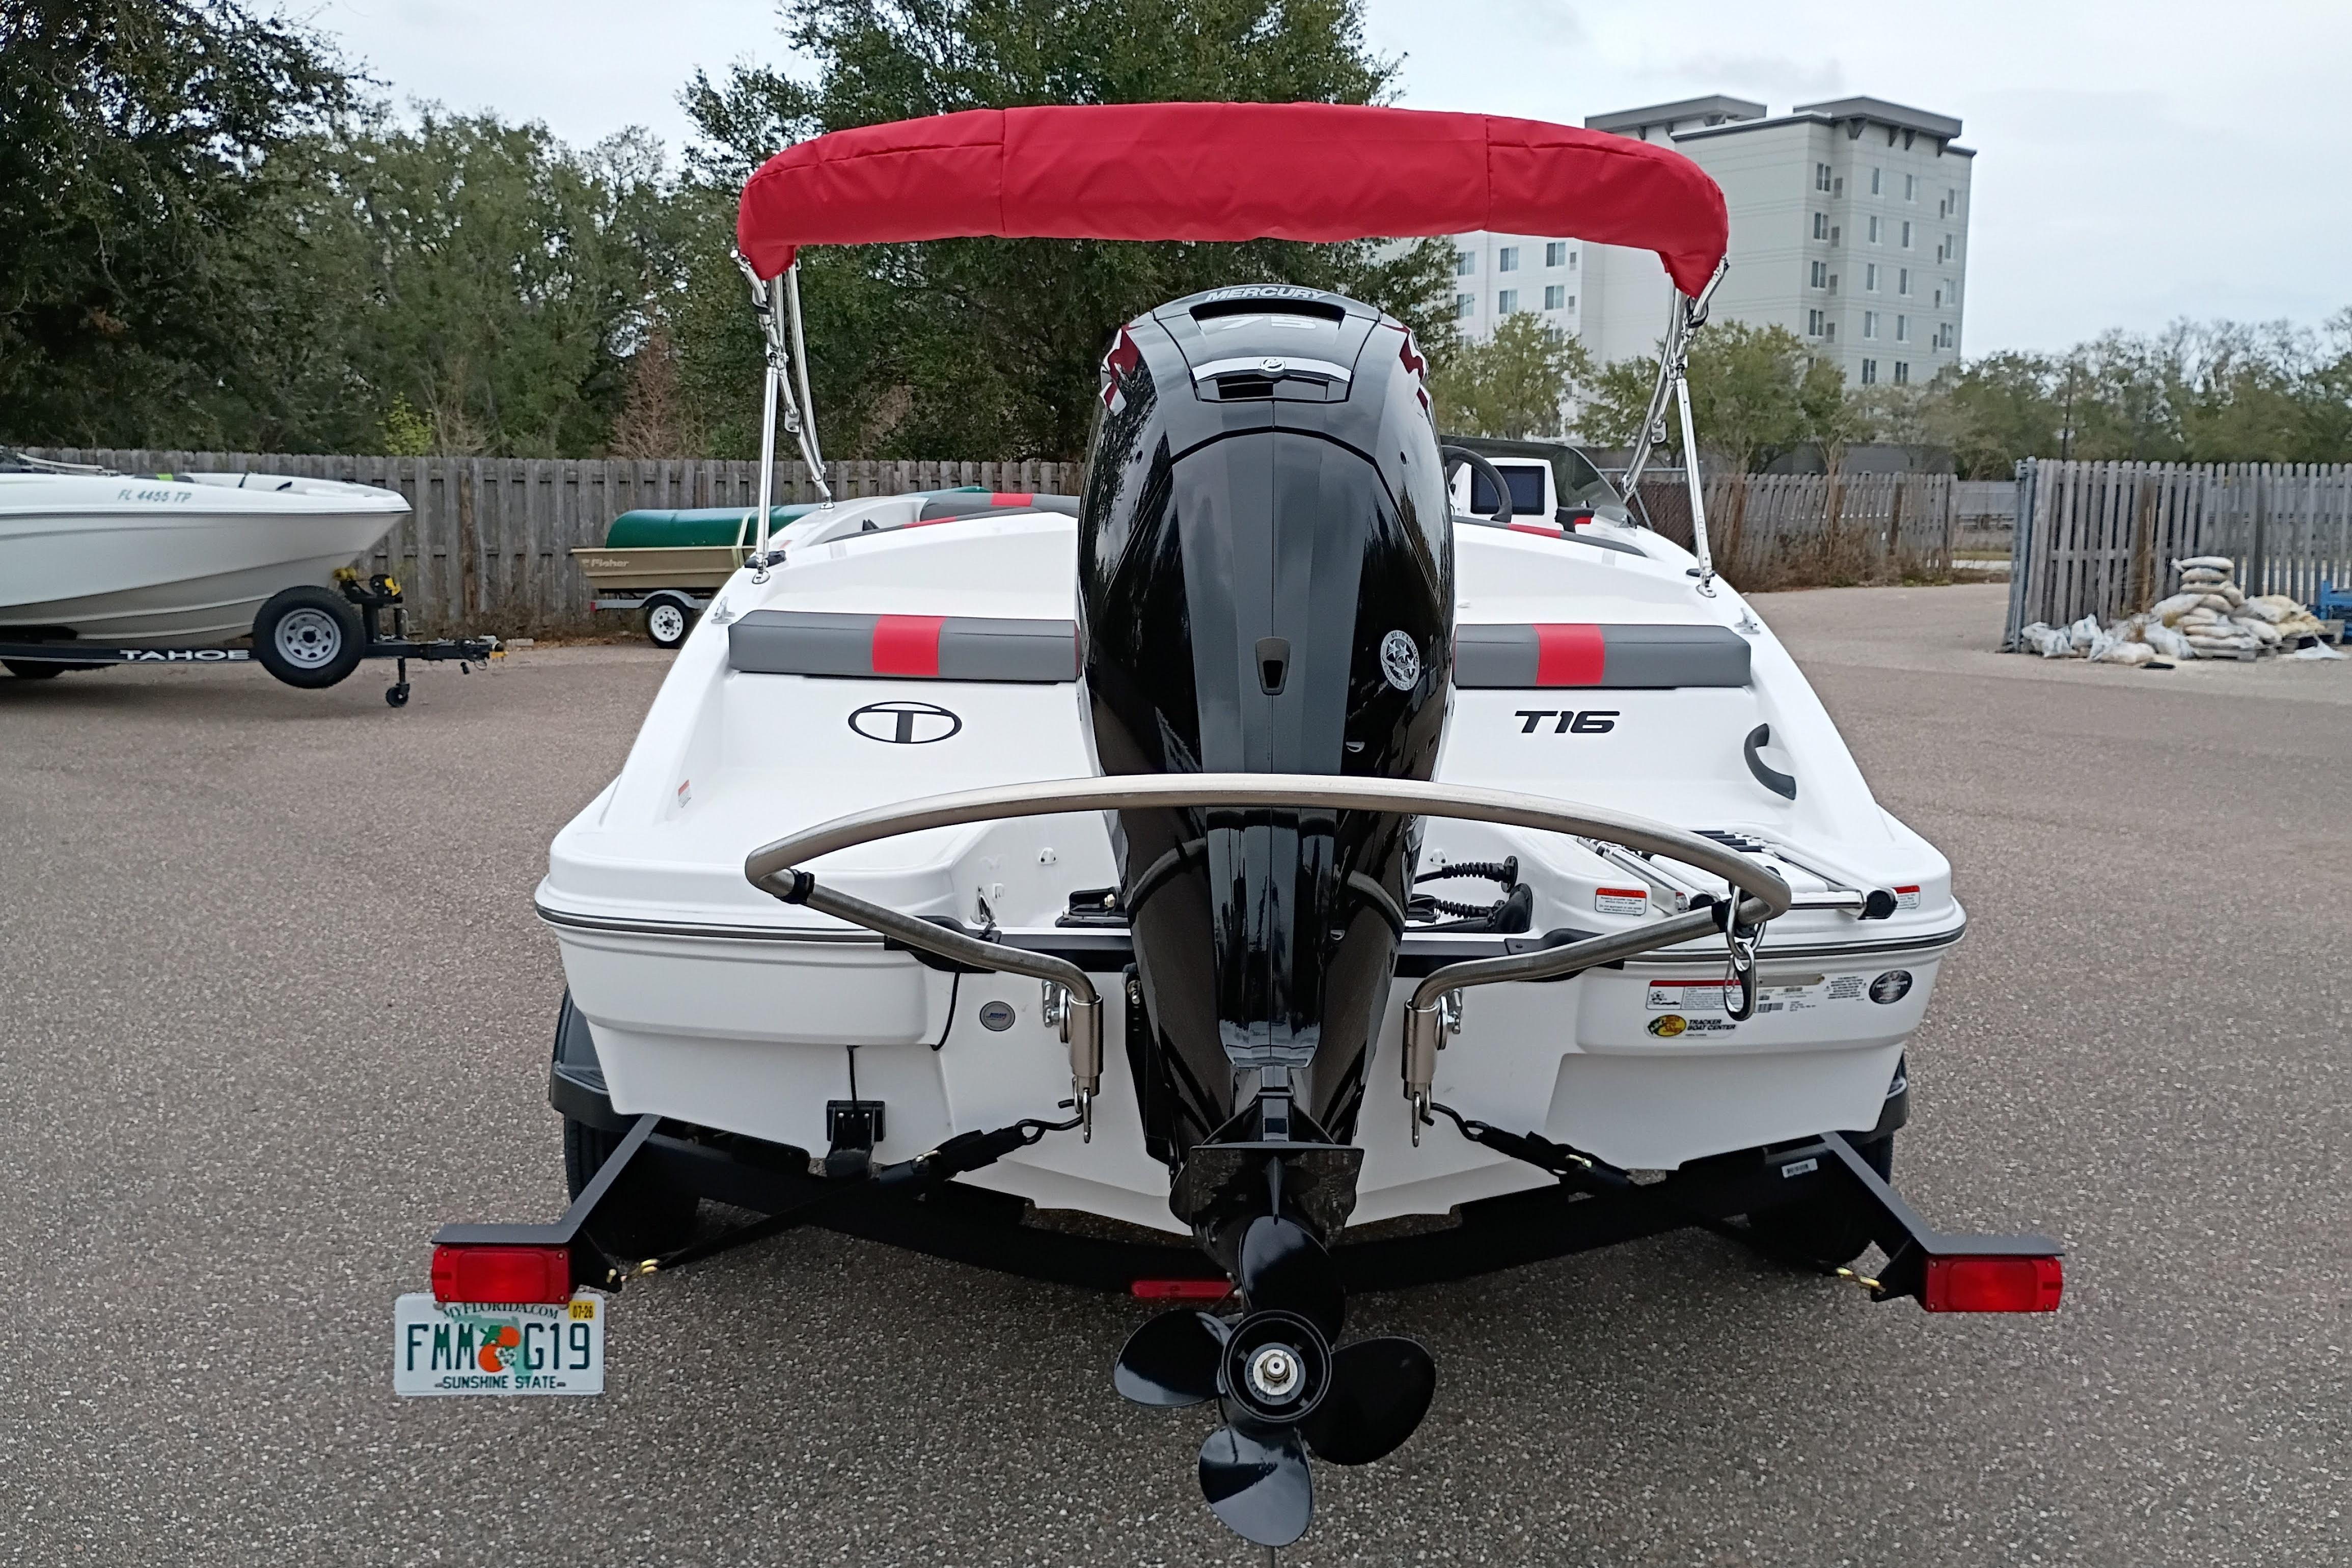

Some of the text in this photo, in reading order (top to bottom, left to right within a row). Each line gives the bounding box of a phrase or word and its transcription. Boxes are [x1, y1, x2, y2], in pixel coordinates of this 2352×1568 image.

[1205, 287, 1327, 302] MERCURY
[1221, 316, 1317, 329] 75
[118, 489, 132, 501] FL
[119, 649, 251, 661] TAHOE
[1515, 710, 1620, 733] T16
[407, 1323, 590, 1371] FMM G19
[443, 1376, 557, 1390] SUNSHINE STATE
